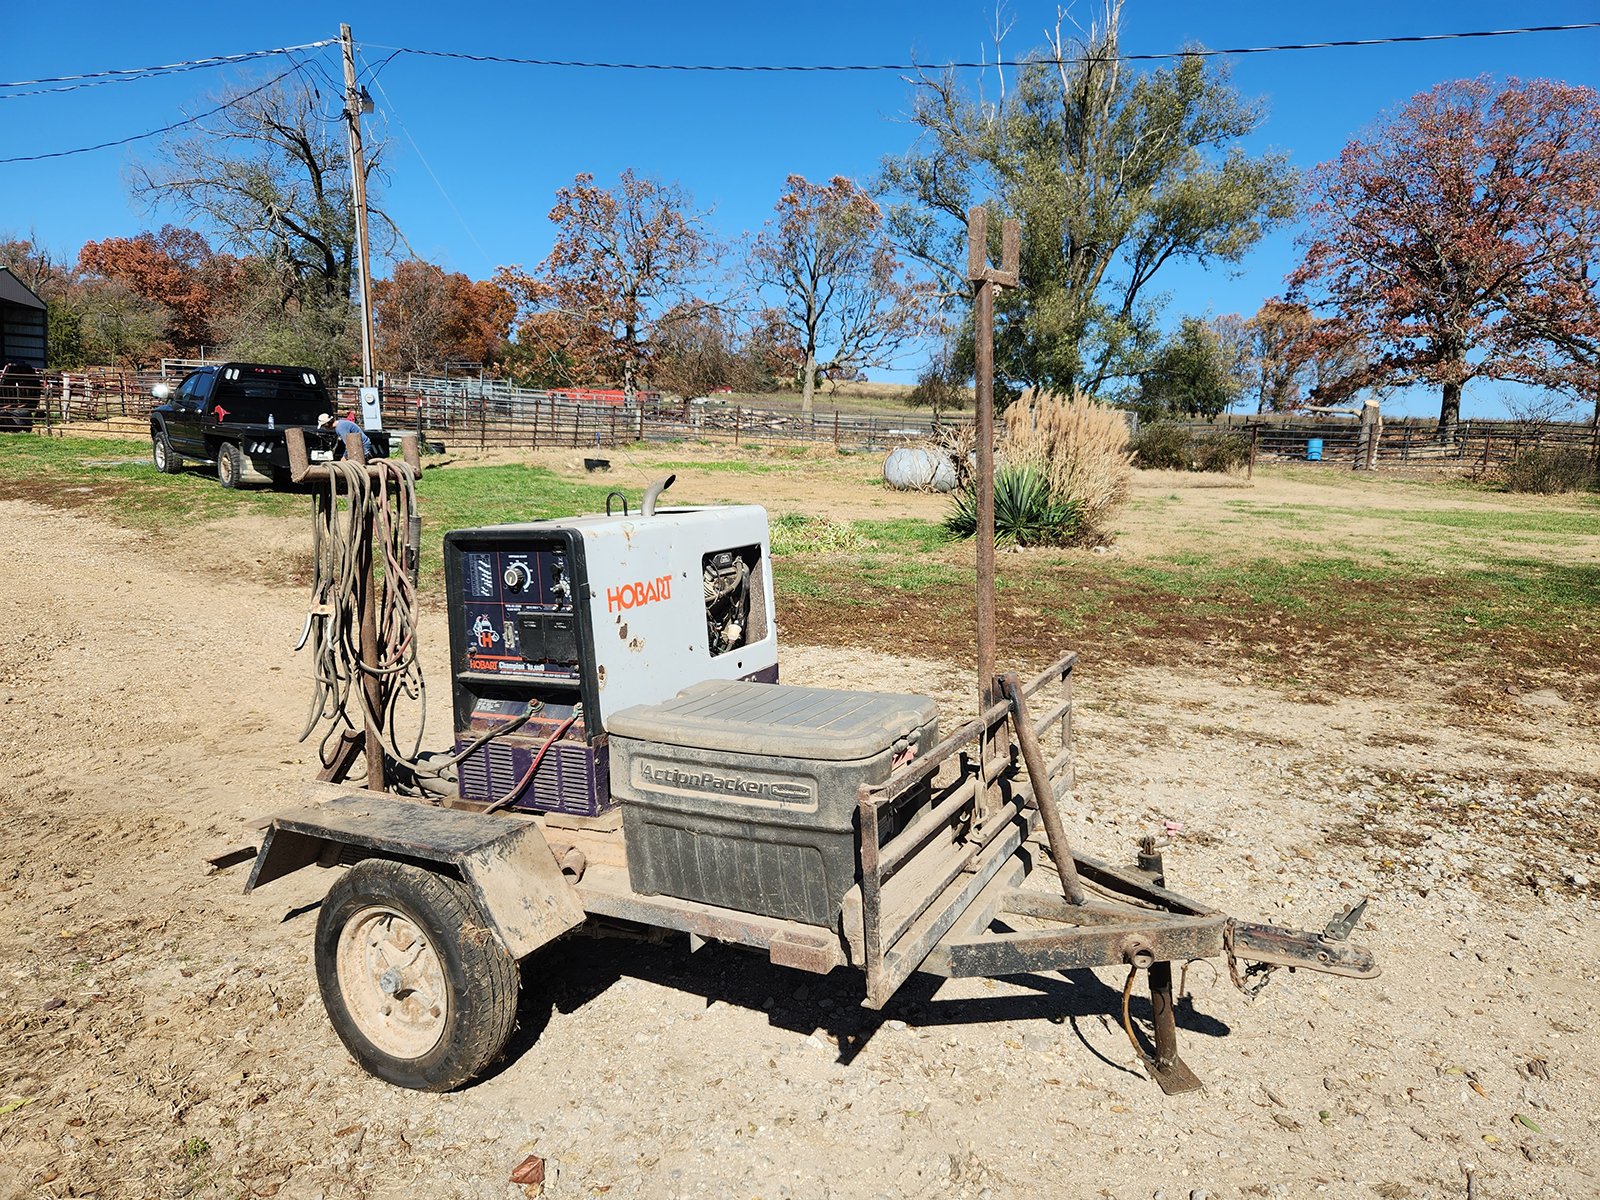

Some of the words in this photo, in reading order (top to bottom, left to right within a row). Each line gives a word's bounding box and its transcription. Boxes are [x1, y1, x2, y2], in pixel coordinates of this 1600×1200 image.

[607, 575, 672, 613] HOBART
[469, 659, 498, 671] HOBART
[641, 763, 769, 795] ActionPacker
